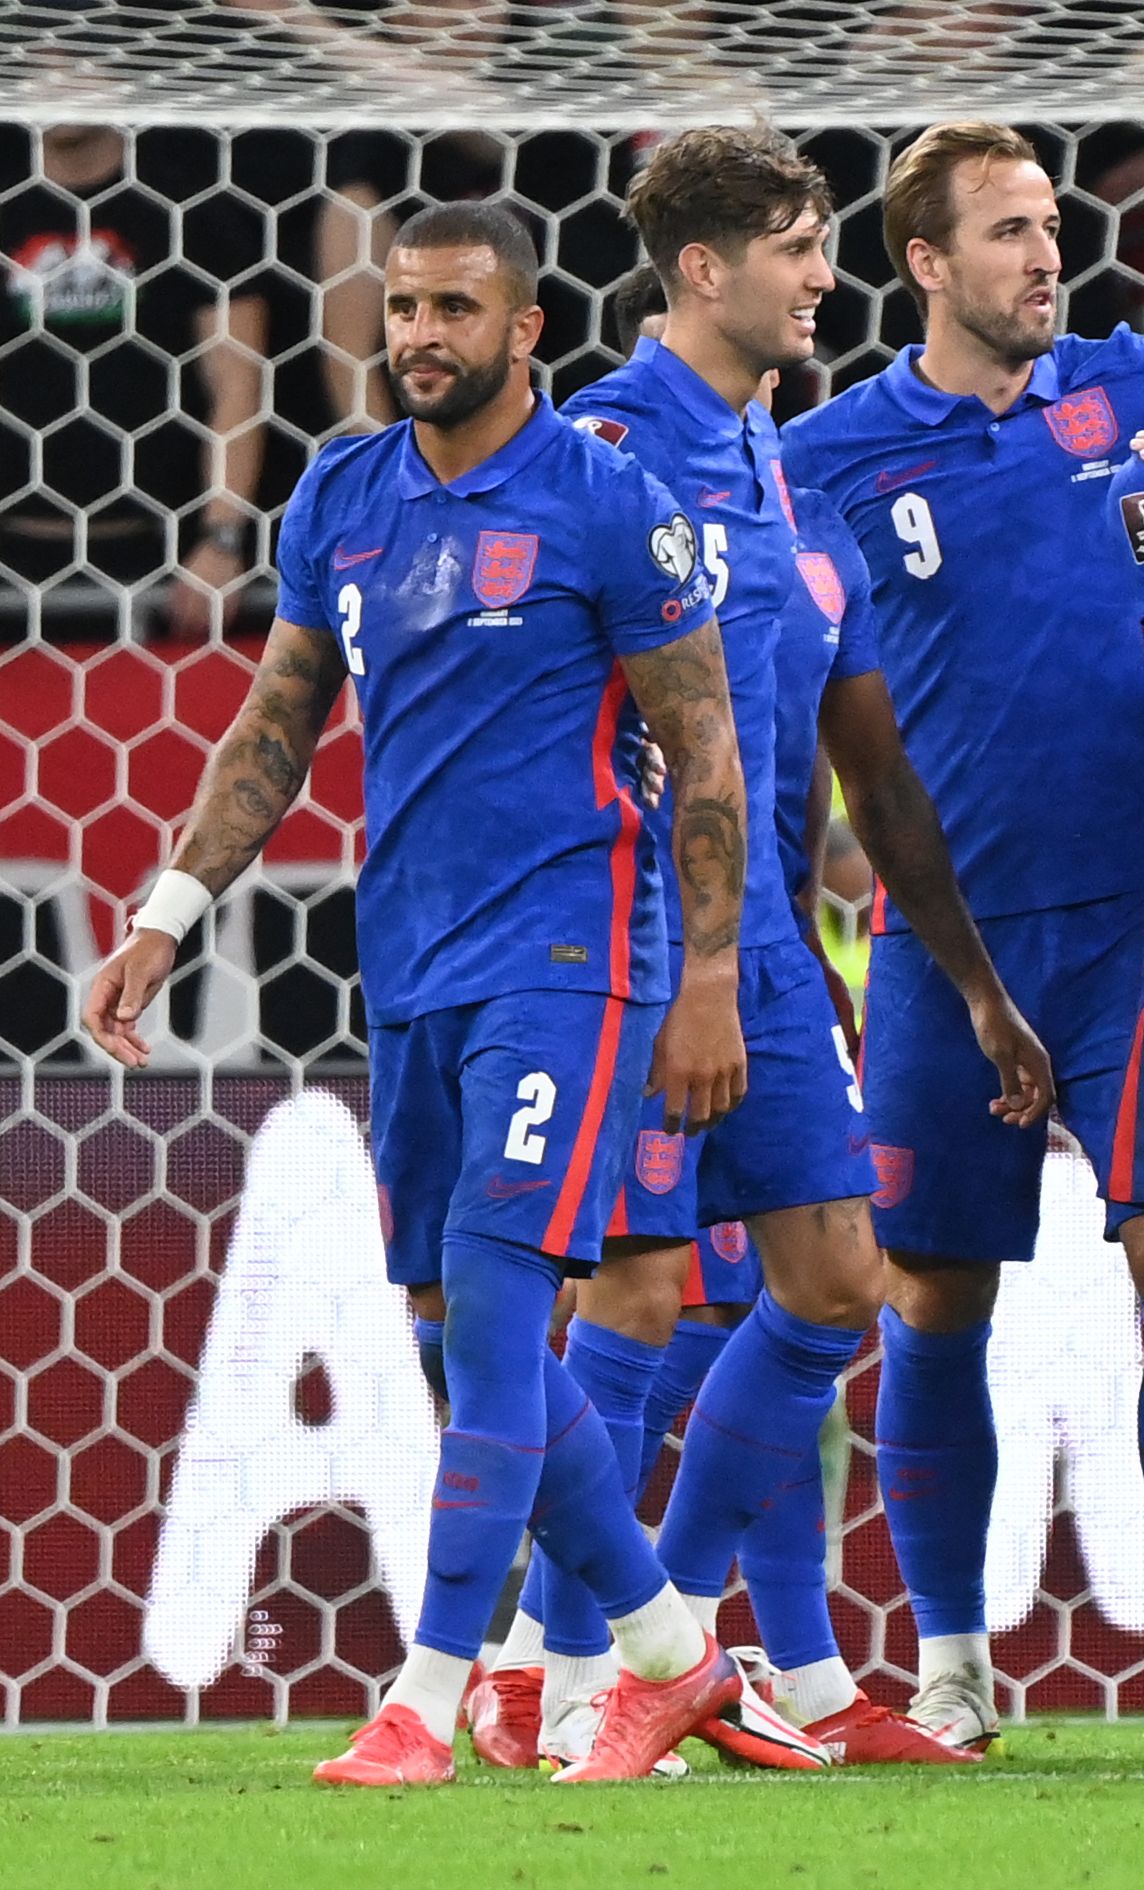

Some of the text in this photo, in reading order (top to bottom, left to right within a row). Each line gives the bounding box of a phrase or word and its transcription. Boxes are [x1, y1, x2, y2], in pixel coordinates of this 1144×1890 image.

[703, 523, 729, 608] 5
[891, 492, 942, 579] 9
[337, 583, 366, 676] 2
[503, 1071, 557, 1165] 2
